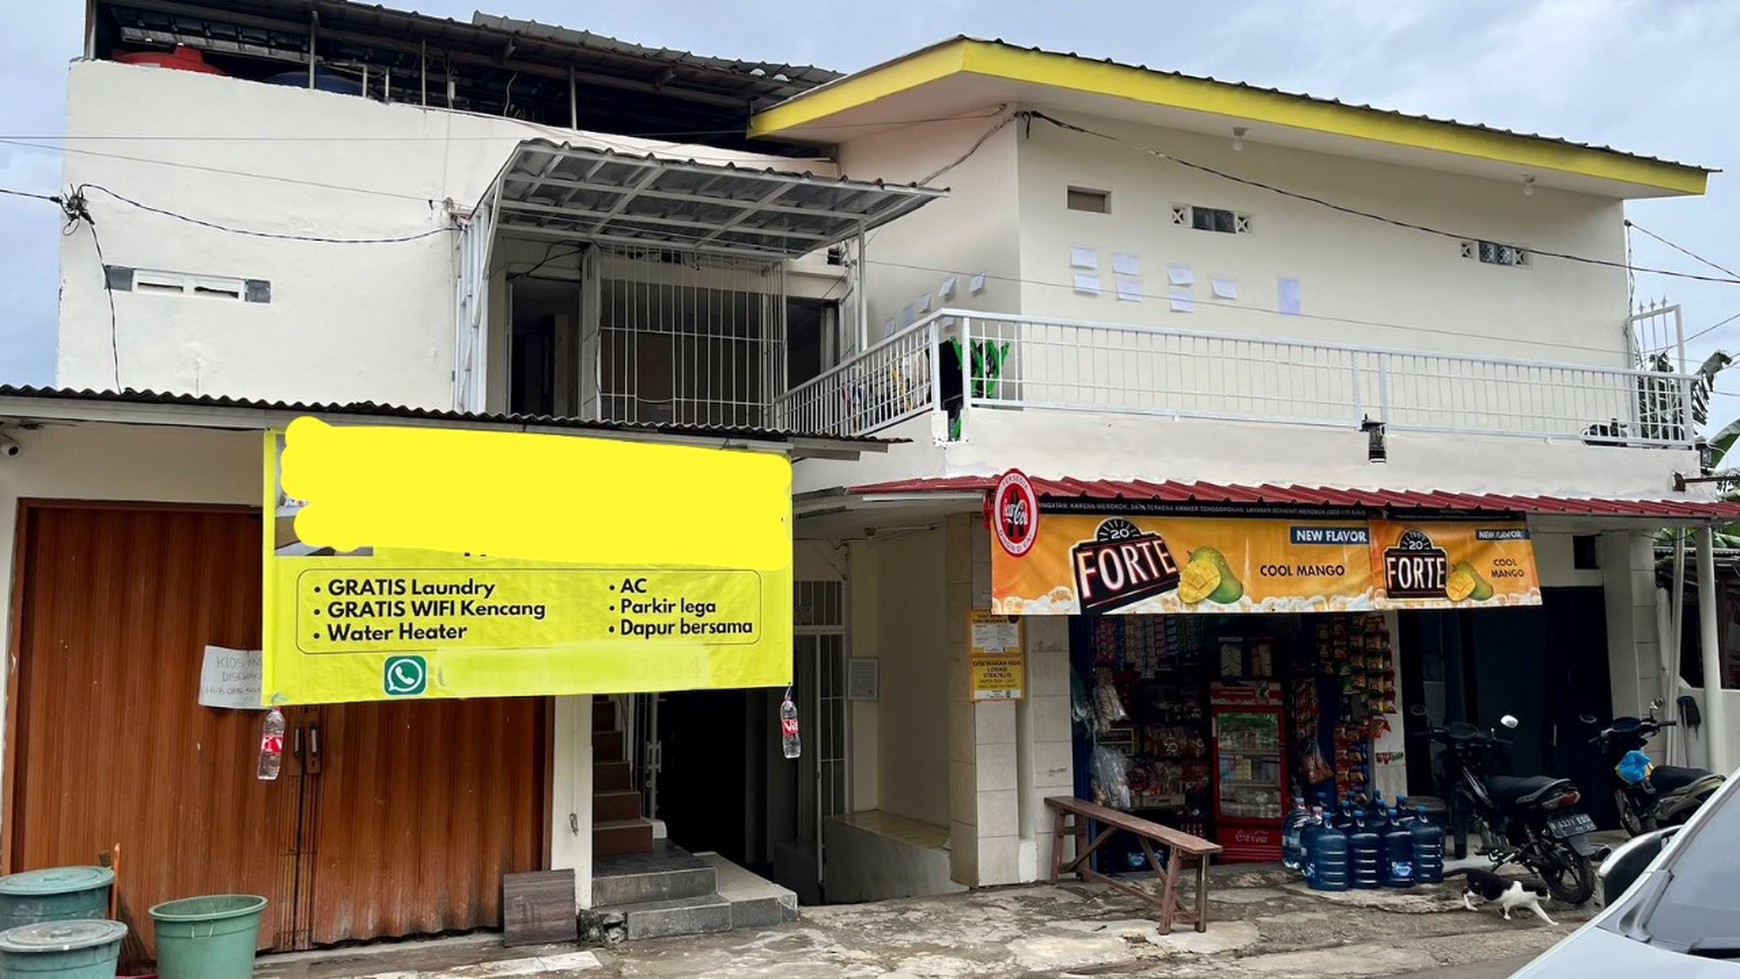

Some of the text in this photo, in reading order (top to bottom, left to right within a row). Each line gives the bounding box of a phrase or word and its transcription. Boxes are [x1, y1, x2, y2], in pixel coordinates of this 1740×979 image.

[1070, 502, 1096, 510] KARENA
[1147, 504, 1174, 512] TERKENA
[1110, 528, 1130, 540] 20
[1296, 529, 1367, 542] NEW FLAVOR
[1478, 530, 1523, 540] NEW FLAVOR
[1408, 540, 1423, 550] 20
[1076, 539, 1178, 599] FORTE
[1493, 558, 1517, 567] COOL
[1260, 564, 1346, 577] COOL MANGO
[1386, 556, 1447, 590] FORTE
[1490, 569, 1525, 578] MANGO
[328, 577, 496, 599] GRATIS Laundry
[620, 577, 648, 594] AC
[327, 599, 546, 620] GRATIS WIFI Kencang
[620, 597, 716, 617] Parkir lega
[327, 622, 468, 641] Water Heater
[620, 618, 753, 639] Dapur bersama
[216, 655, 245, 669] KIOS
